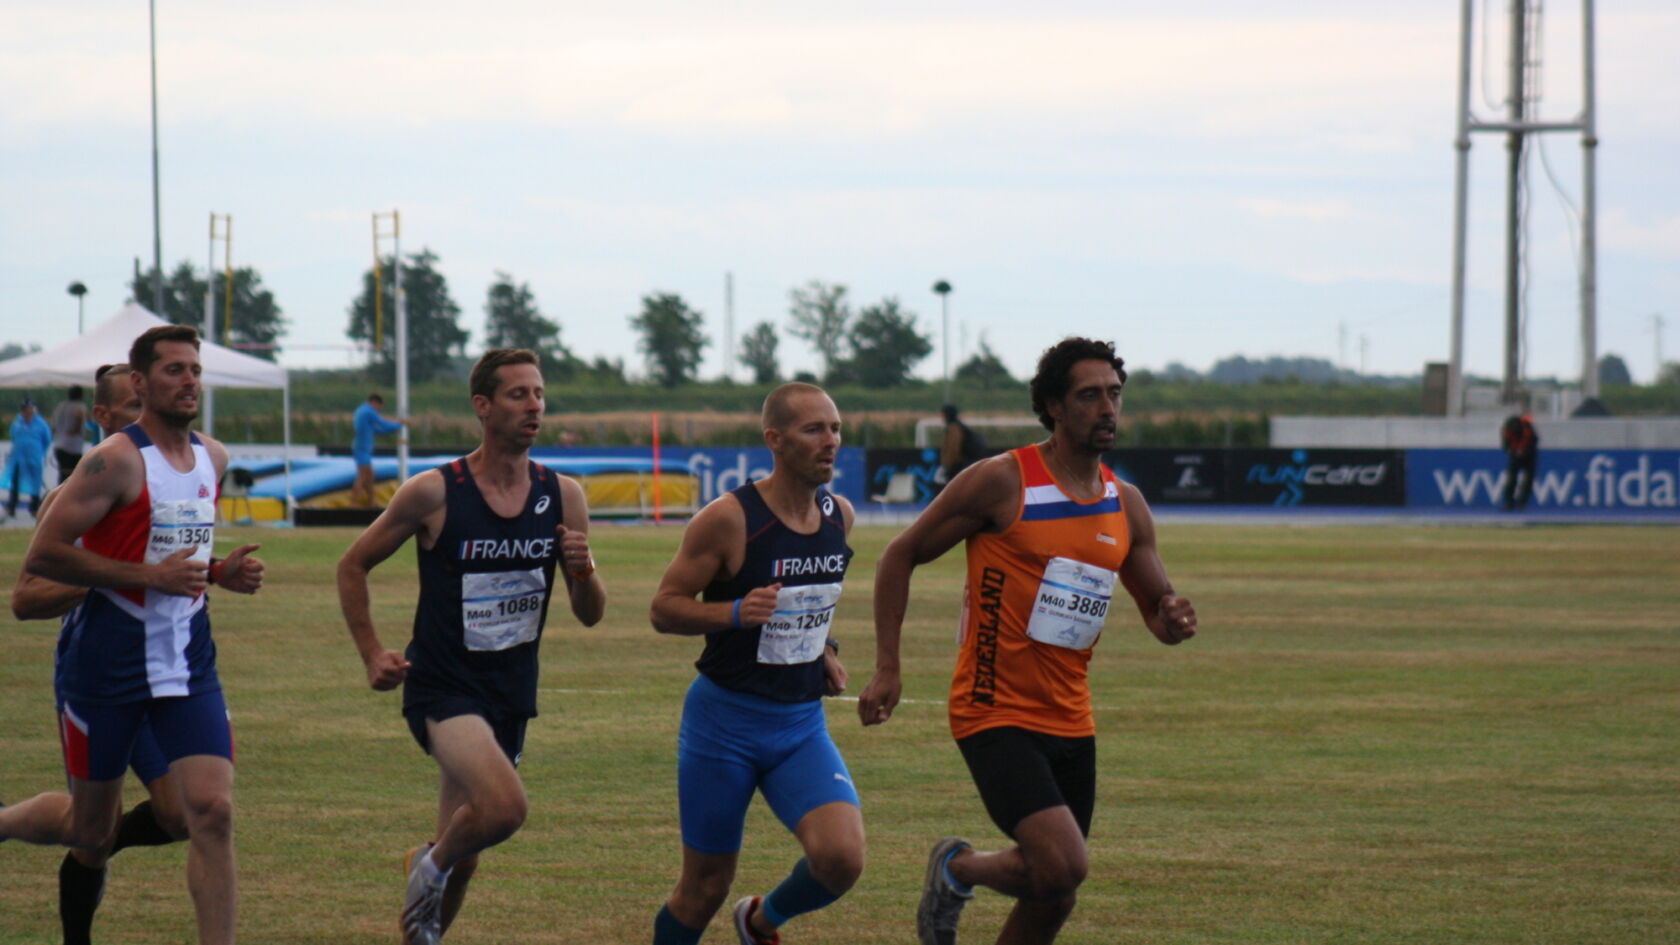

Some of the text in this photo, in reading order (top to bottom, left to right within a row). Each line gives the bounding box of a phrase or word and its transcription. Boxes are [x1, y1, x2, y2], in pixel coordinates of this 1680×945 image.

[1433, 454, 1680, 506] www.fida
[177, 528, 210, 544] 1350
[471, 538, 554, 559] FRANCE
[781, 555, 844, 576] FRANCE
[467, 595, 539, 620] M40 1088
[1040, 593, 1066, 609] M40
[1067, 594, 1107, 617] 3880
[766, 611, 830, 631] M40 1204
[971, 566, 1006, 706] NEDERLAND
